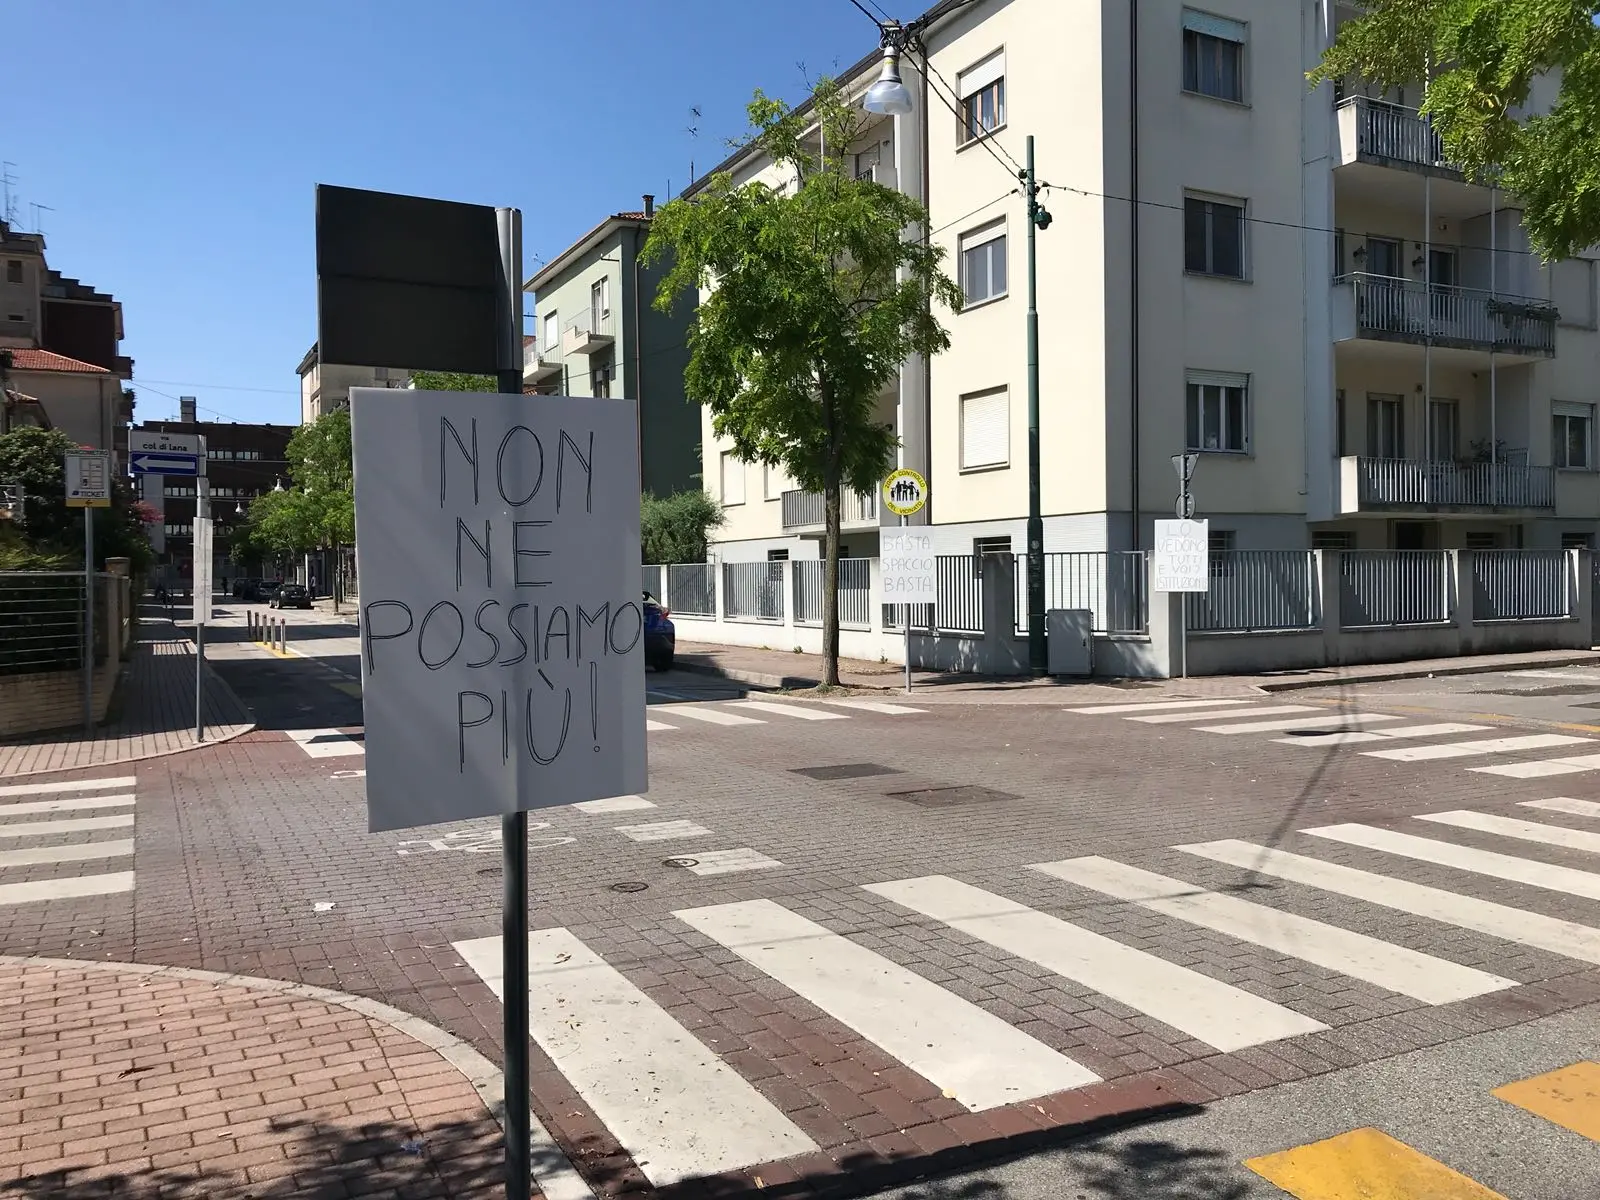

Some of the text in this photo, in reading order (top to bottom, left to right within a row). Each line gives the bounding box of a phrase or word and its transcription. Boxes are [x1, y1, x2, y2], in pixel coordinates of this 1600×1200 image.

[142, 442, 157, 450] col
[169, 443, 188, 451] lana
[439, 415, 594, 514] NON
[885, 470, 926, 489] ZONA CONTROLLO
[79, 490, 105, 498] TICKET
[887, 501, 923, 513] DEL VICINATO
[1167, 521, 1192, 538] LO
[883, 535, 931, 552] BASTA
[1157, 538, 1207, 553] VEDONO
[455, 516, 553, 592] NE
[1167, 554, 1203, 565] TUTTI
[882, 557, 933, 573] SPACCIO
[1158, 564, 1165, 575] E
[363, 599, 642, 676] POSSIAMO
